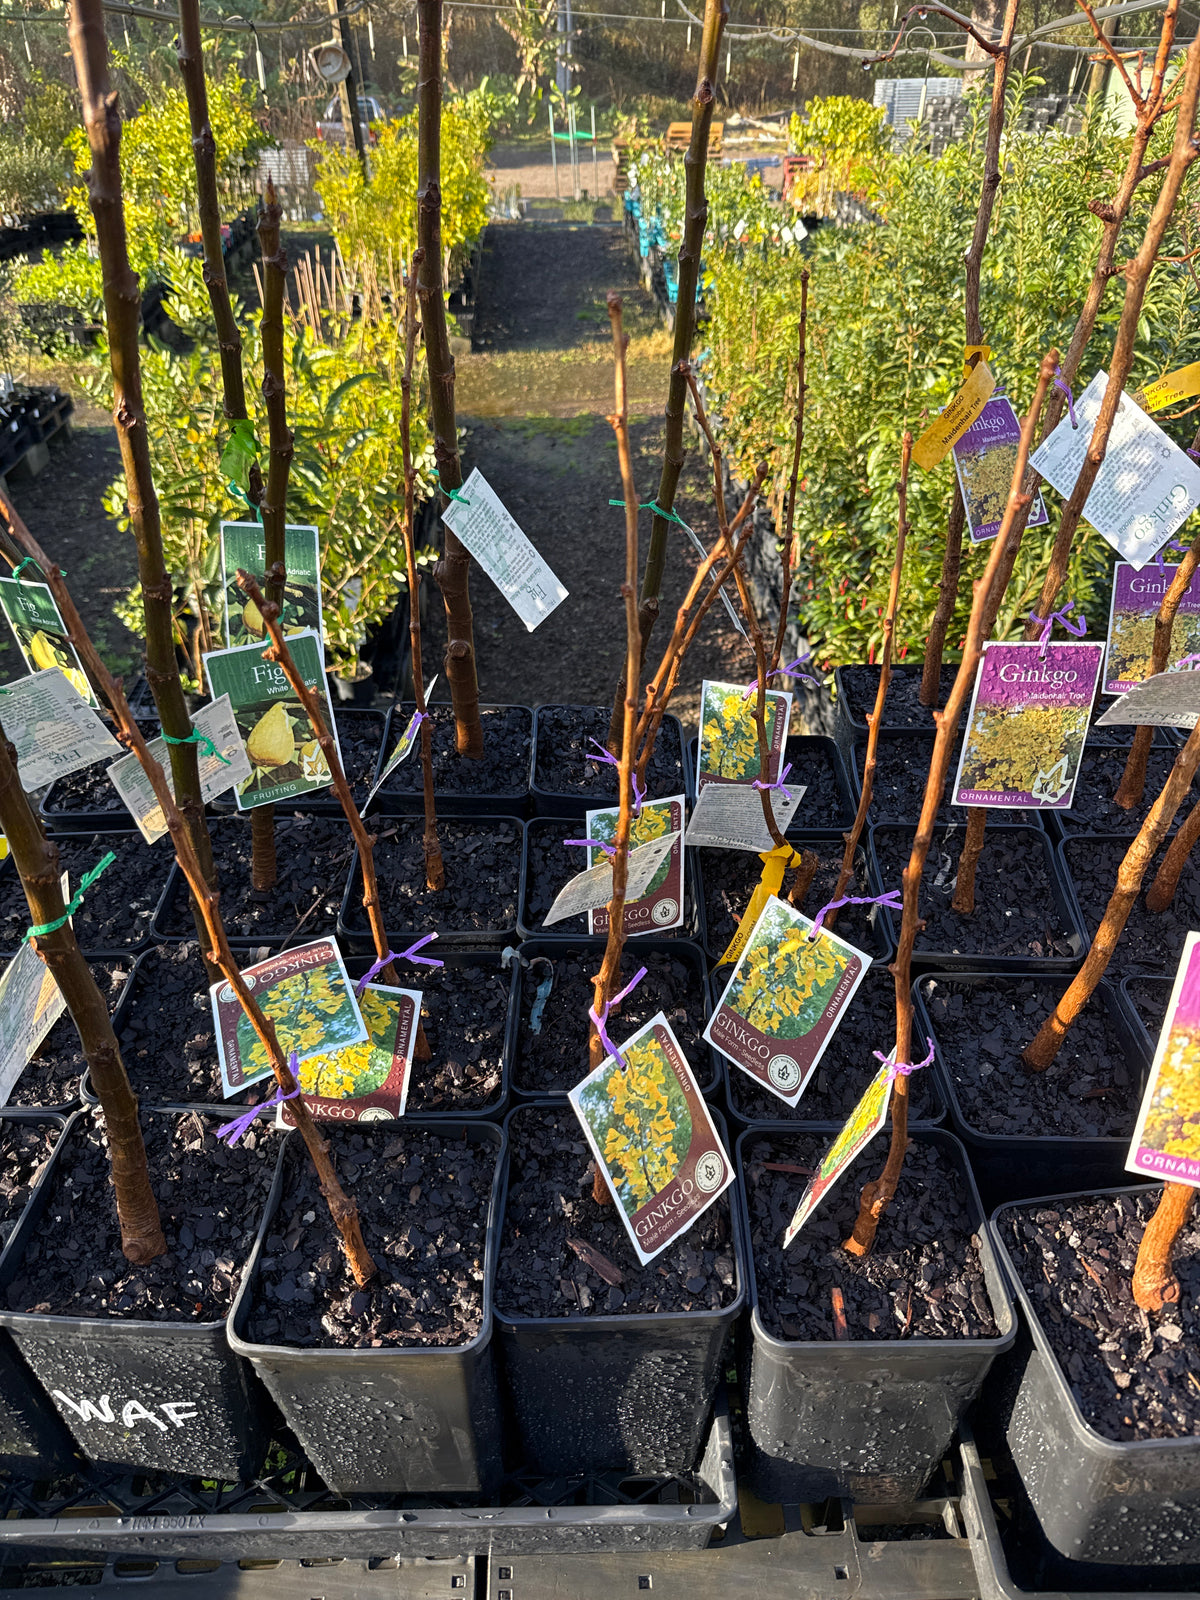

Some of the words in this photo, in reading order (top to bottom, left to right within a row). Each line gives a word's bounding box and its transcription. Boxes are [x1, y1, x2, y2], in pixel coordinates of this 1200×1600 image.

[942, 410, 973, 446] Maidenhair
[972, 397, 981, 410] Tree
[944, 395, 964, 420] GINKGO
[1134, 482, 1188, 542] Ginkgo
[1150, 498, 1196, 552] ORNAMENTAL
[1130, 578, 1192, 594] Ginko
[17, 596, 39, 617] Fig
[251, 664, 286, 684] Fig
[1000, 664, 1077, 689] Ginkgo
[267, 686, 288, 694] White
[774, 703, 786, 750] ORNAMENTAL
[48, 750, 81, 765] Fig
[252, 783, 297, 801] FRUITING
[960, 792, 1029, 803] ORNAMENTAL
[594, 908, 649, 926] GIGO
[726, 932, 743, 959] GINKGO
[260, 950, 334, 983] GINKGO
[826, 965, 858, 1018] ORNAMENTAL
[397, 1004, 412, 1060] ORNAMENTAL
[716, 1012, 769, 1059] GINKGO
[725, 1036, 739, 1051] Form
[226, 1039, 241, 1082] ORNAMENTAL
[660, 1030, 690, 1092] ORNAMENTAL
[284, 1102, 356, 1119] NKGO
[635, 1180, 693, 1237] GINKGO
[642, 1230, 659, 1247] Male
[658, 1218, 674, 1235] Form
[52, 1389, 198, 1432] WAF
